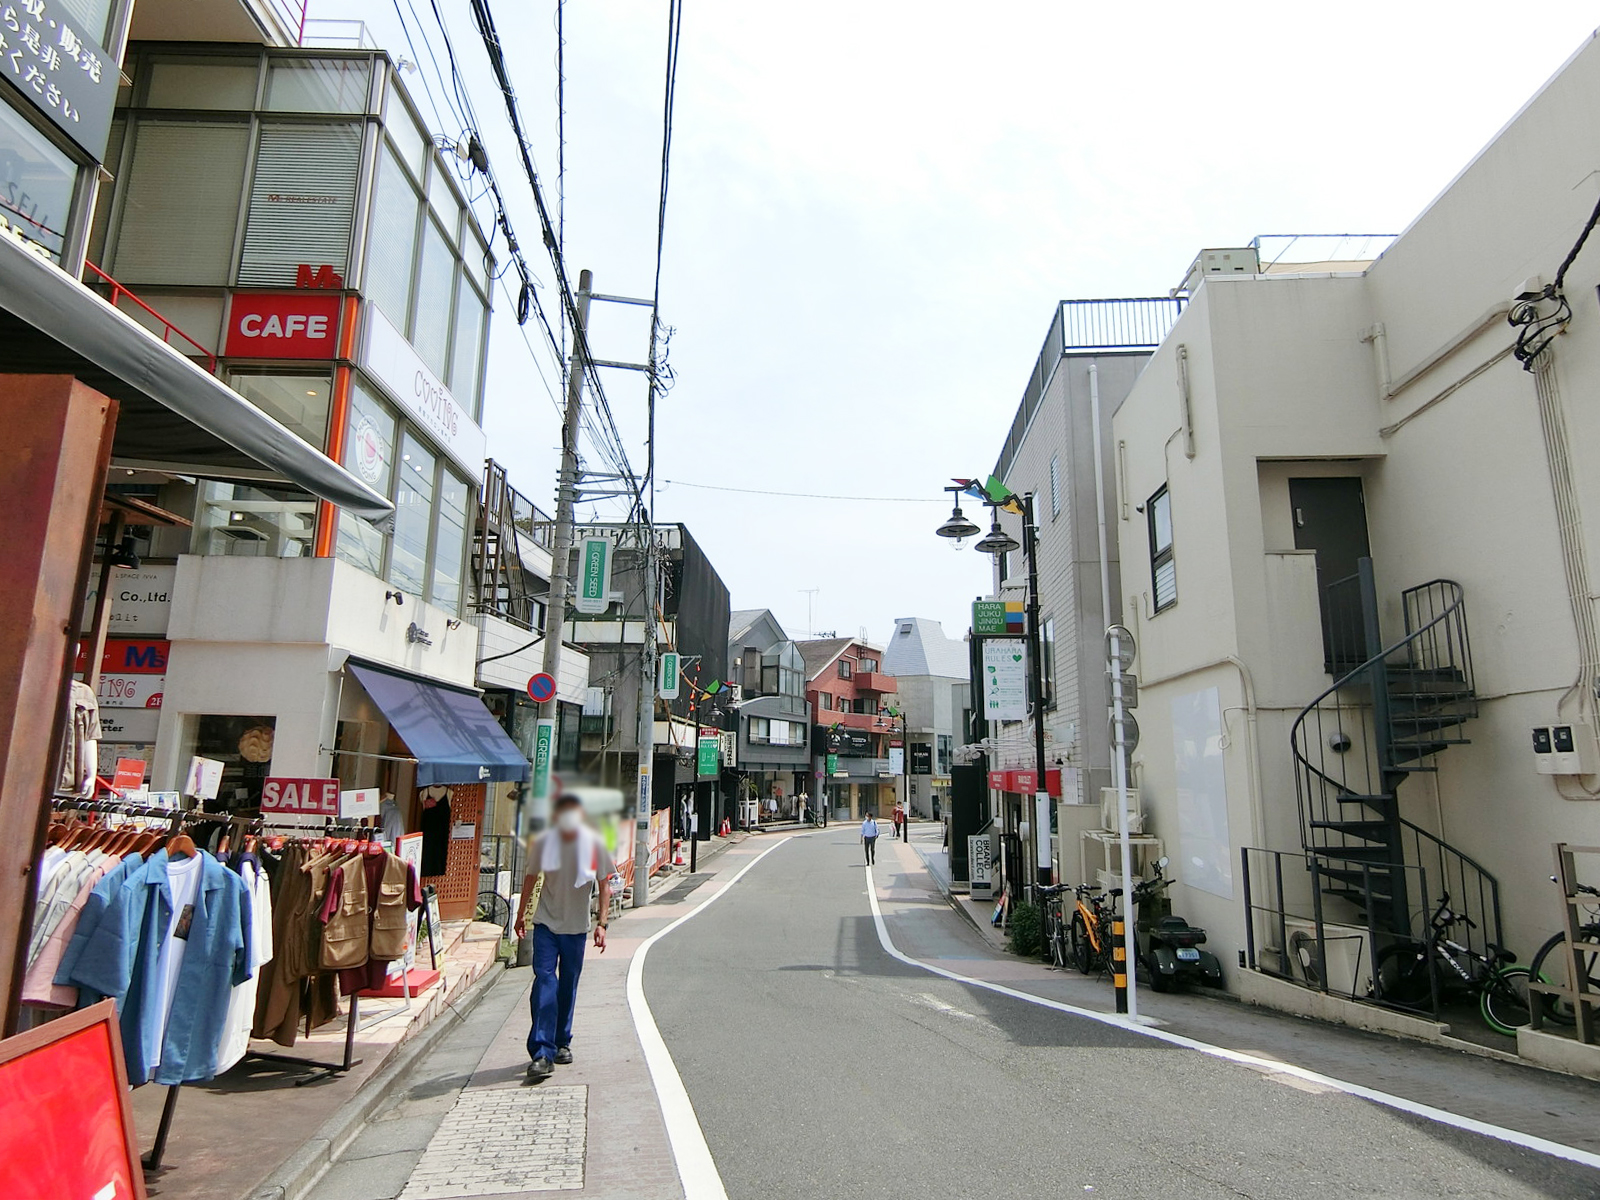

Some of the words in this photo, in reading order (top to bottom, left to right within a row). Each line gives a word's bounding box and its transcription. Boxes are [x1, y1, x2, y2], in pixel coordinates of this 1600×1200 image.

[240, 313, 329, 339] CAFE
[590, 551, 600, 577] GREEN
[120, 590, 171, 603] Co.,Ltd.
[588, 577, 598, 597] SEED
[984, 647, 1023, 655] URAHARA
[537, 738, 549, 771] GREEN
[262, 781, 337, 811] SALE
[983, 839, 991, 870] BRAND
